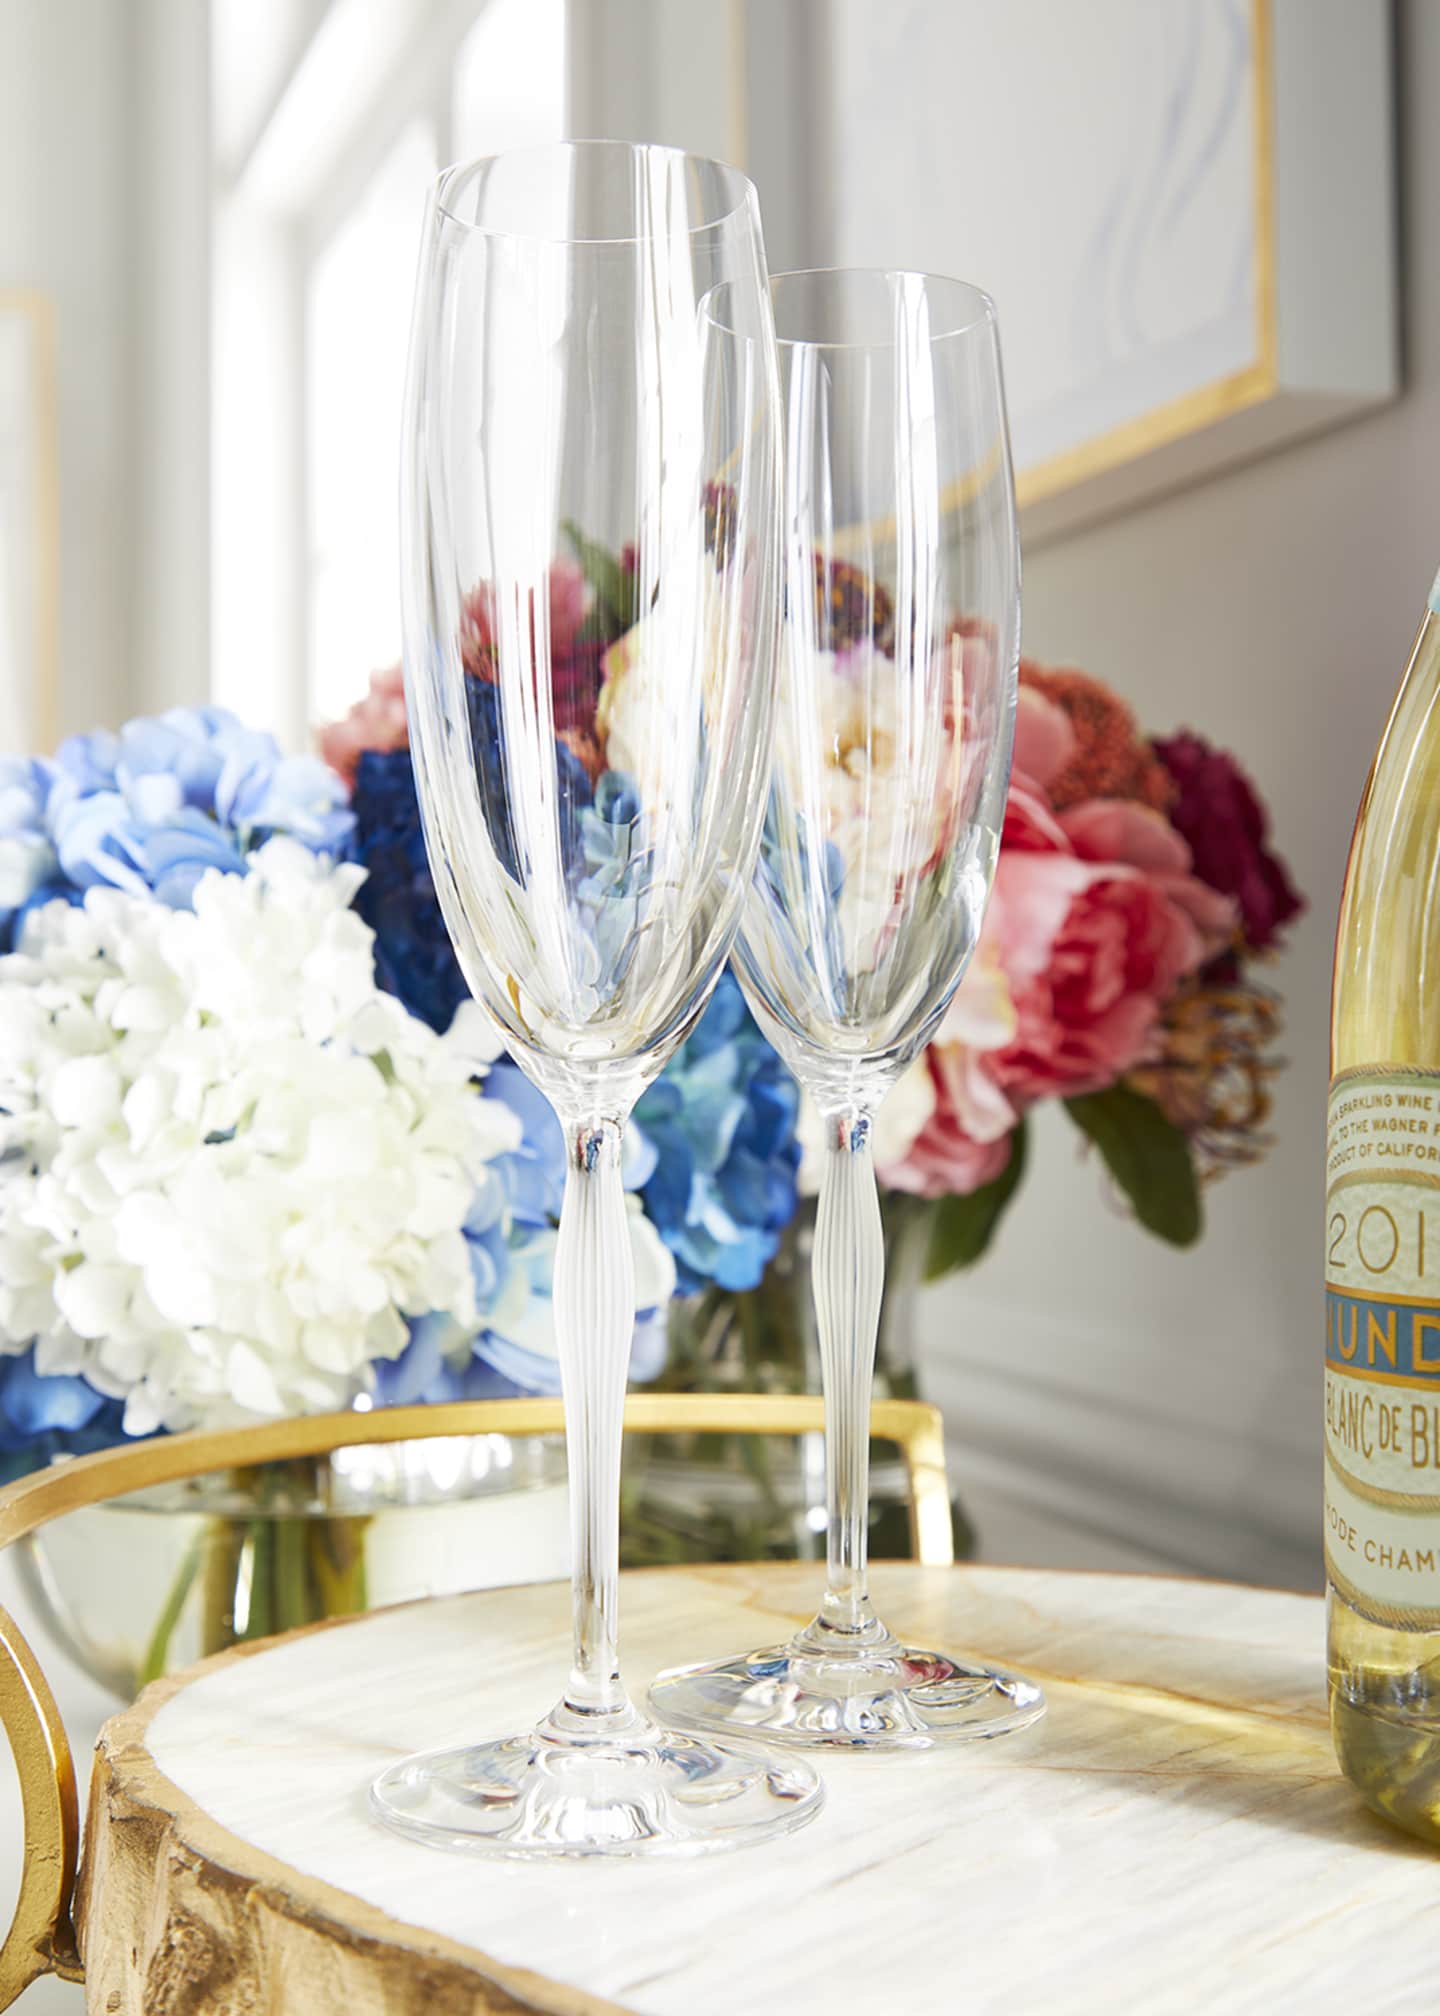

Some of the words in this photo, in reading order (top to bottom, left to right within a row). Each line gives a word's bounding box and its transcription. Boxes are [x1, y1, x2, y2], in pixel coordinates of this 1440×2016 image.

[1339, 1094, 1392, 1118] SPARKLING
[1396, 1095, 1432, 1111] WINE
[1351, 1119, 1369, 1134] THE
[1372, 1118, 1428, 1134] WAGNER
[1360, 1143, 1373, 1158] OF
[1377, 1142, 1440, 1162] CALIFOR
[1329, 1205, 1424, 1277] 201
[1327, 1381, 1374, 1459] BLANC
[1379, 1403, 1402, 1453] DE
[1364, 1540, 1440, 1573] CHAM
